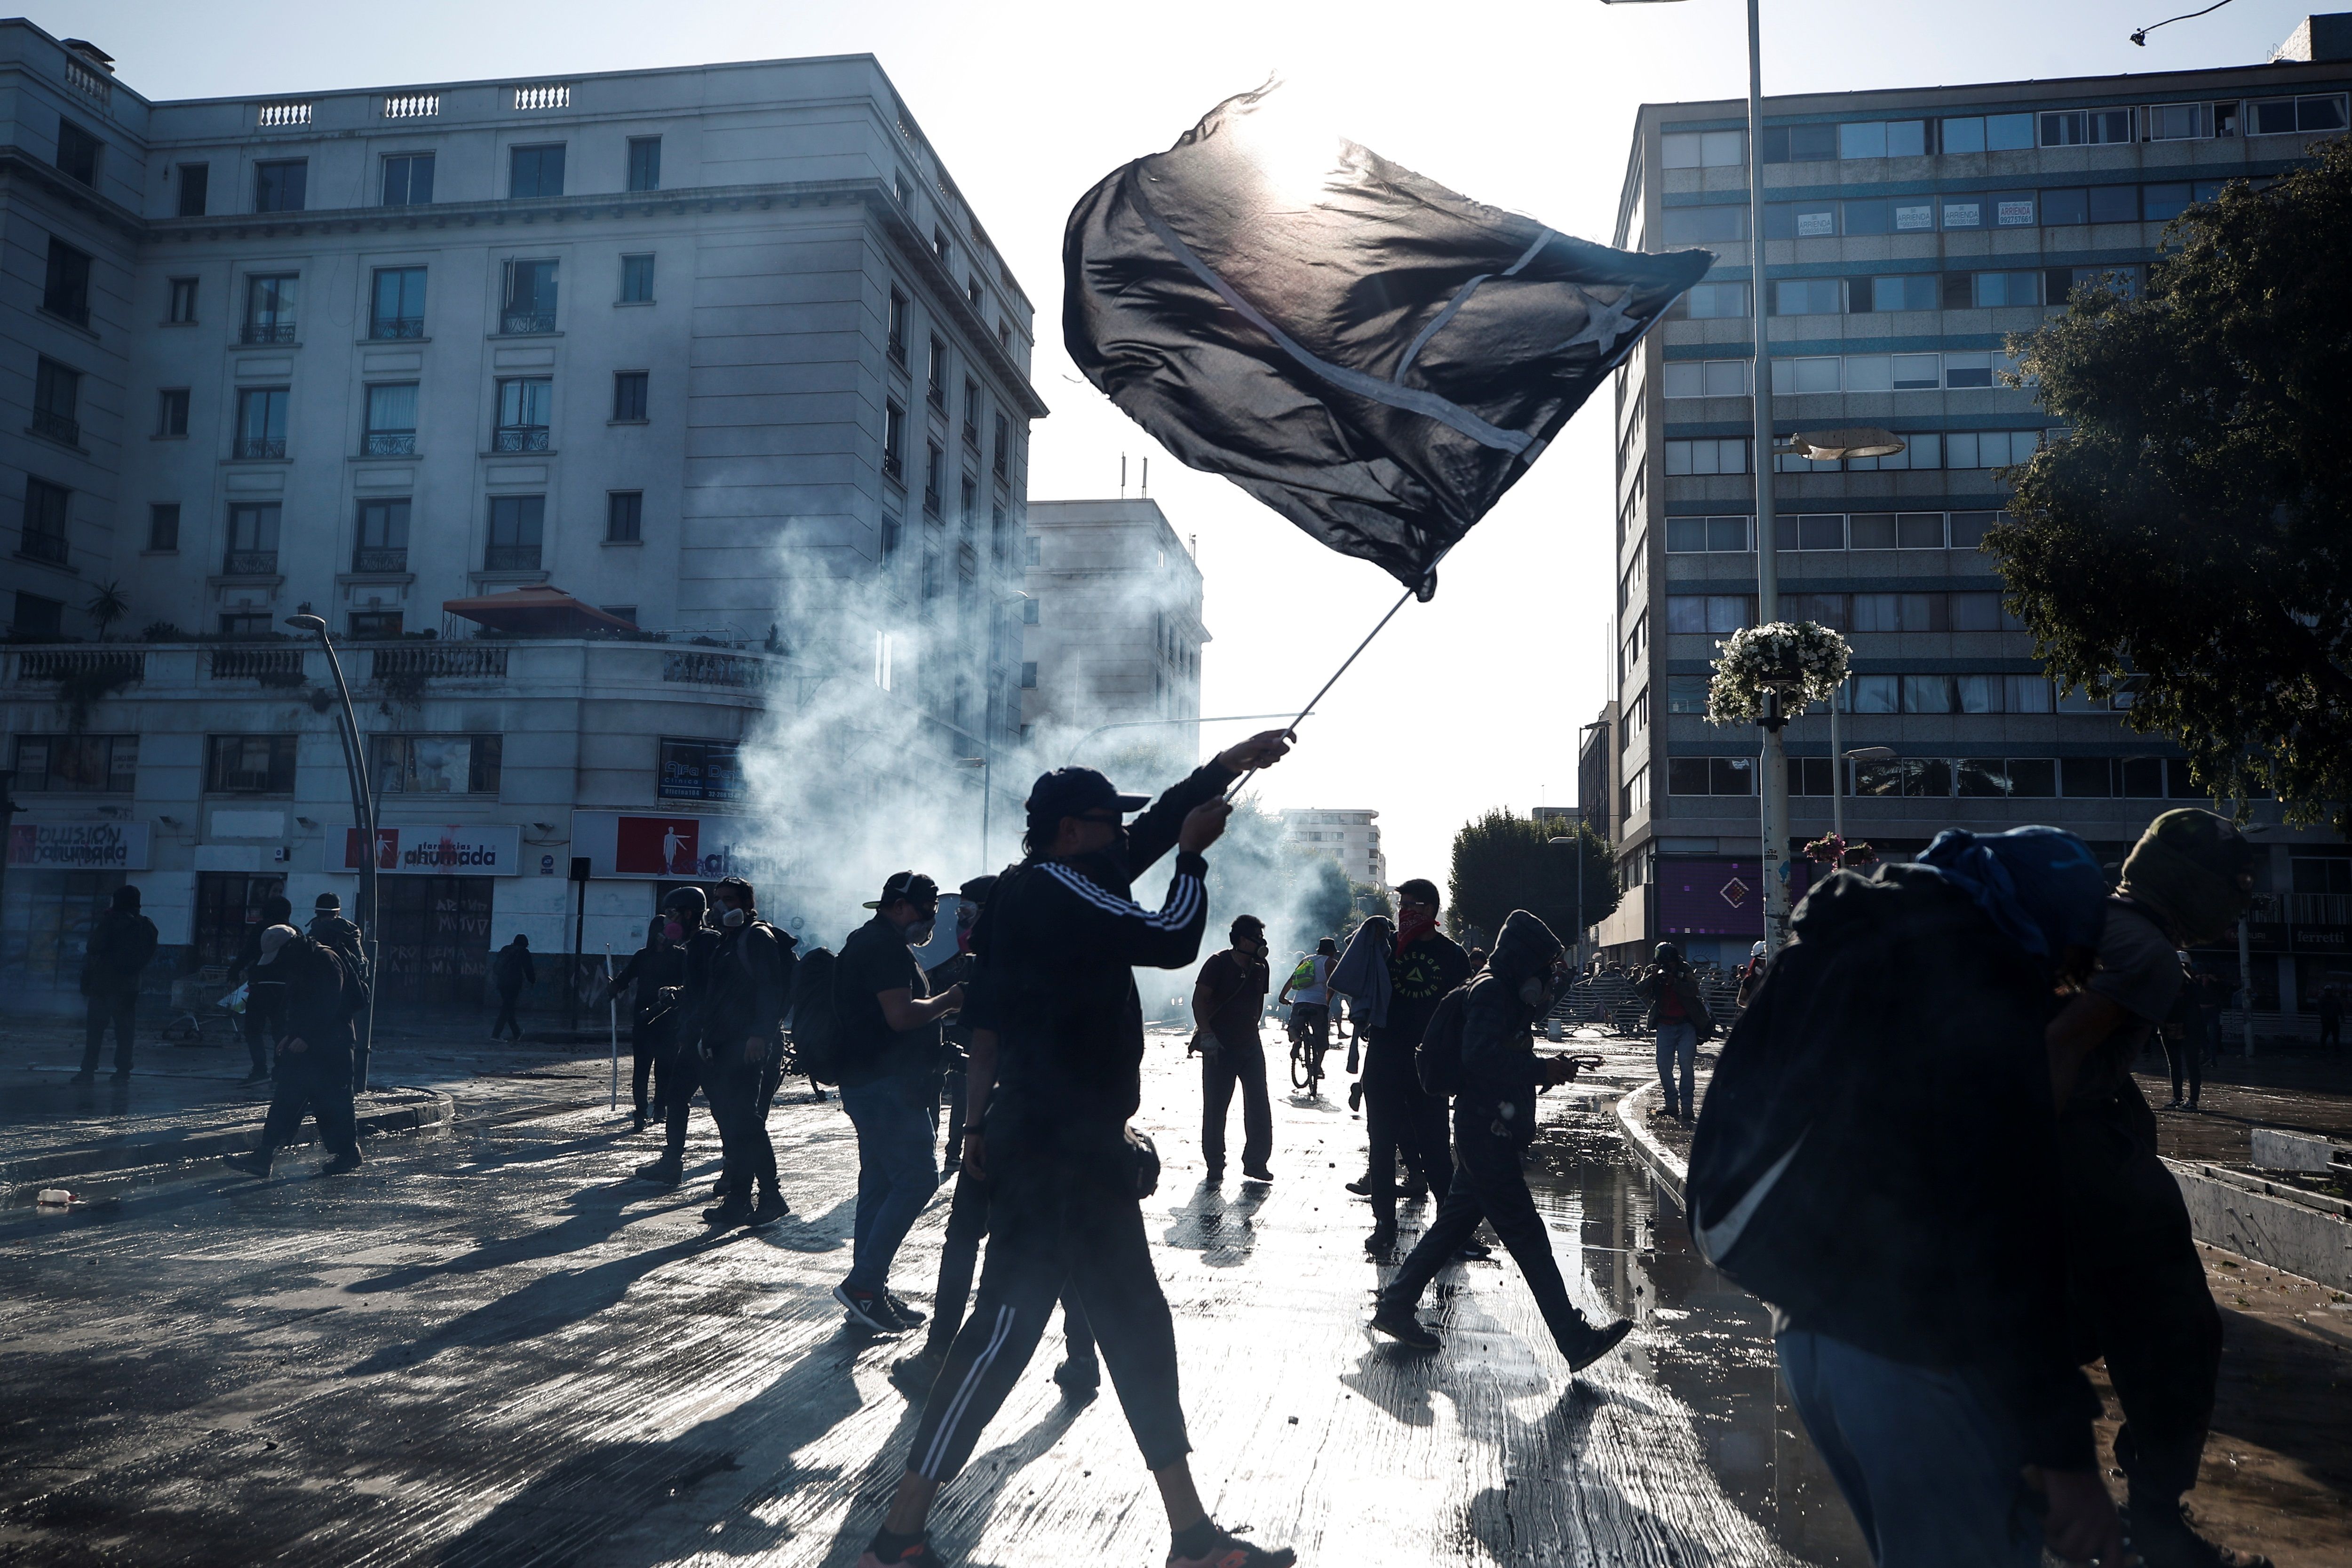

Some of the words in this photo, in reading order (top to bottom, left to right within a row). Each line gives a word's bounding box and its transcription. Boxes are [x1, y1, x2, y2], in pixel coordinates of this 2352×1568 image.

[2001, 206, 2031, 216] ARRIENDA
[1898, 213, 1931, 222] ARRIENDA
[1799, 219, 1832, 229] ARRIENDA
[405, 845, 496, 866] ahumada
[2296, 931, 2344, 943] ferretti
[389, 945, 466, 960] PROLEMA
[1391, 976, 1438, 999] TRAINING
